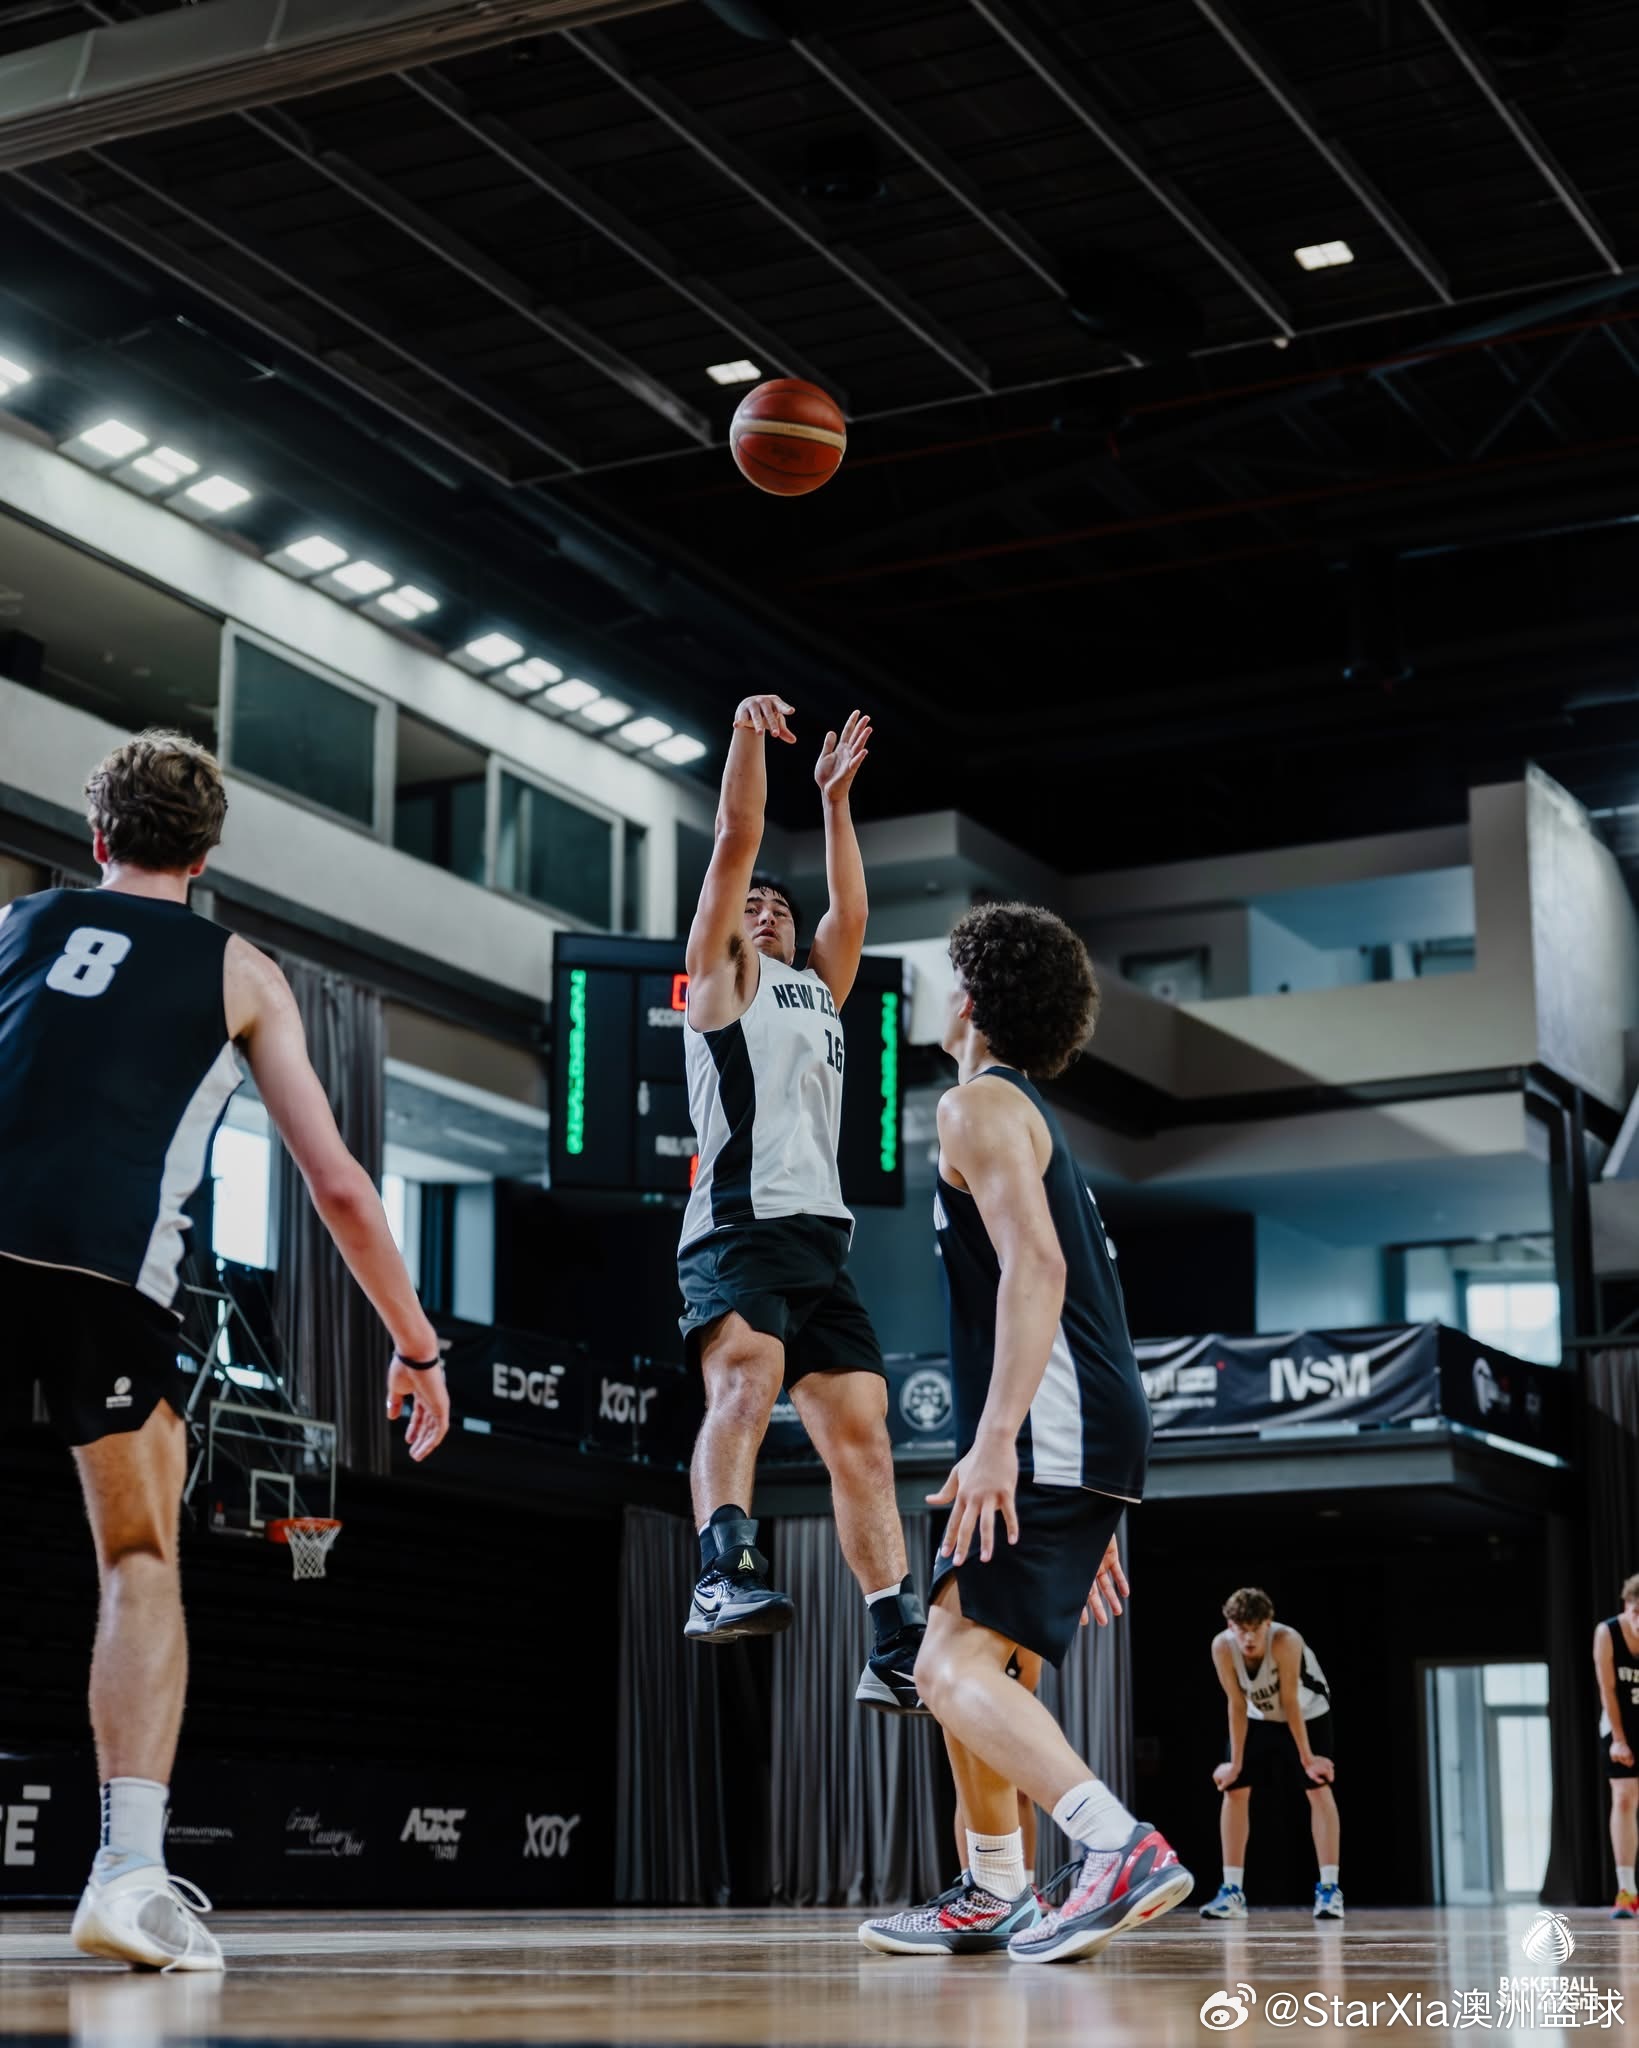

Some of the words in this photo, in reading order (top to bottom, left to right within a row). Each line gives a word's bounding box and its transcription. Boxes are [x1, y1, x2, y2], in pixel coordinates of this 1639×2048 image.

[46, 927, 132, 997] 8
[772, 983, 815, 1010] NEW
[825, 1028, 843, 1075] 16
[493, 1363, 565, 1409] EDGE
